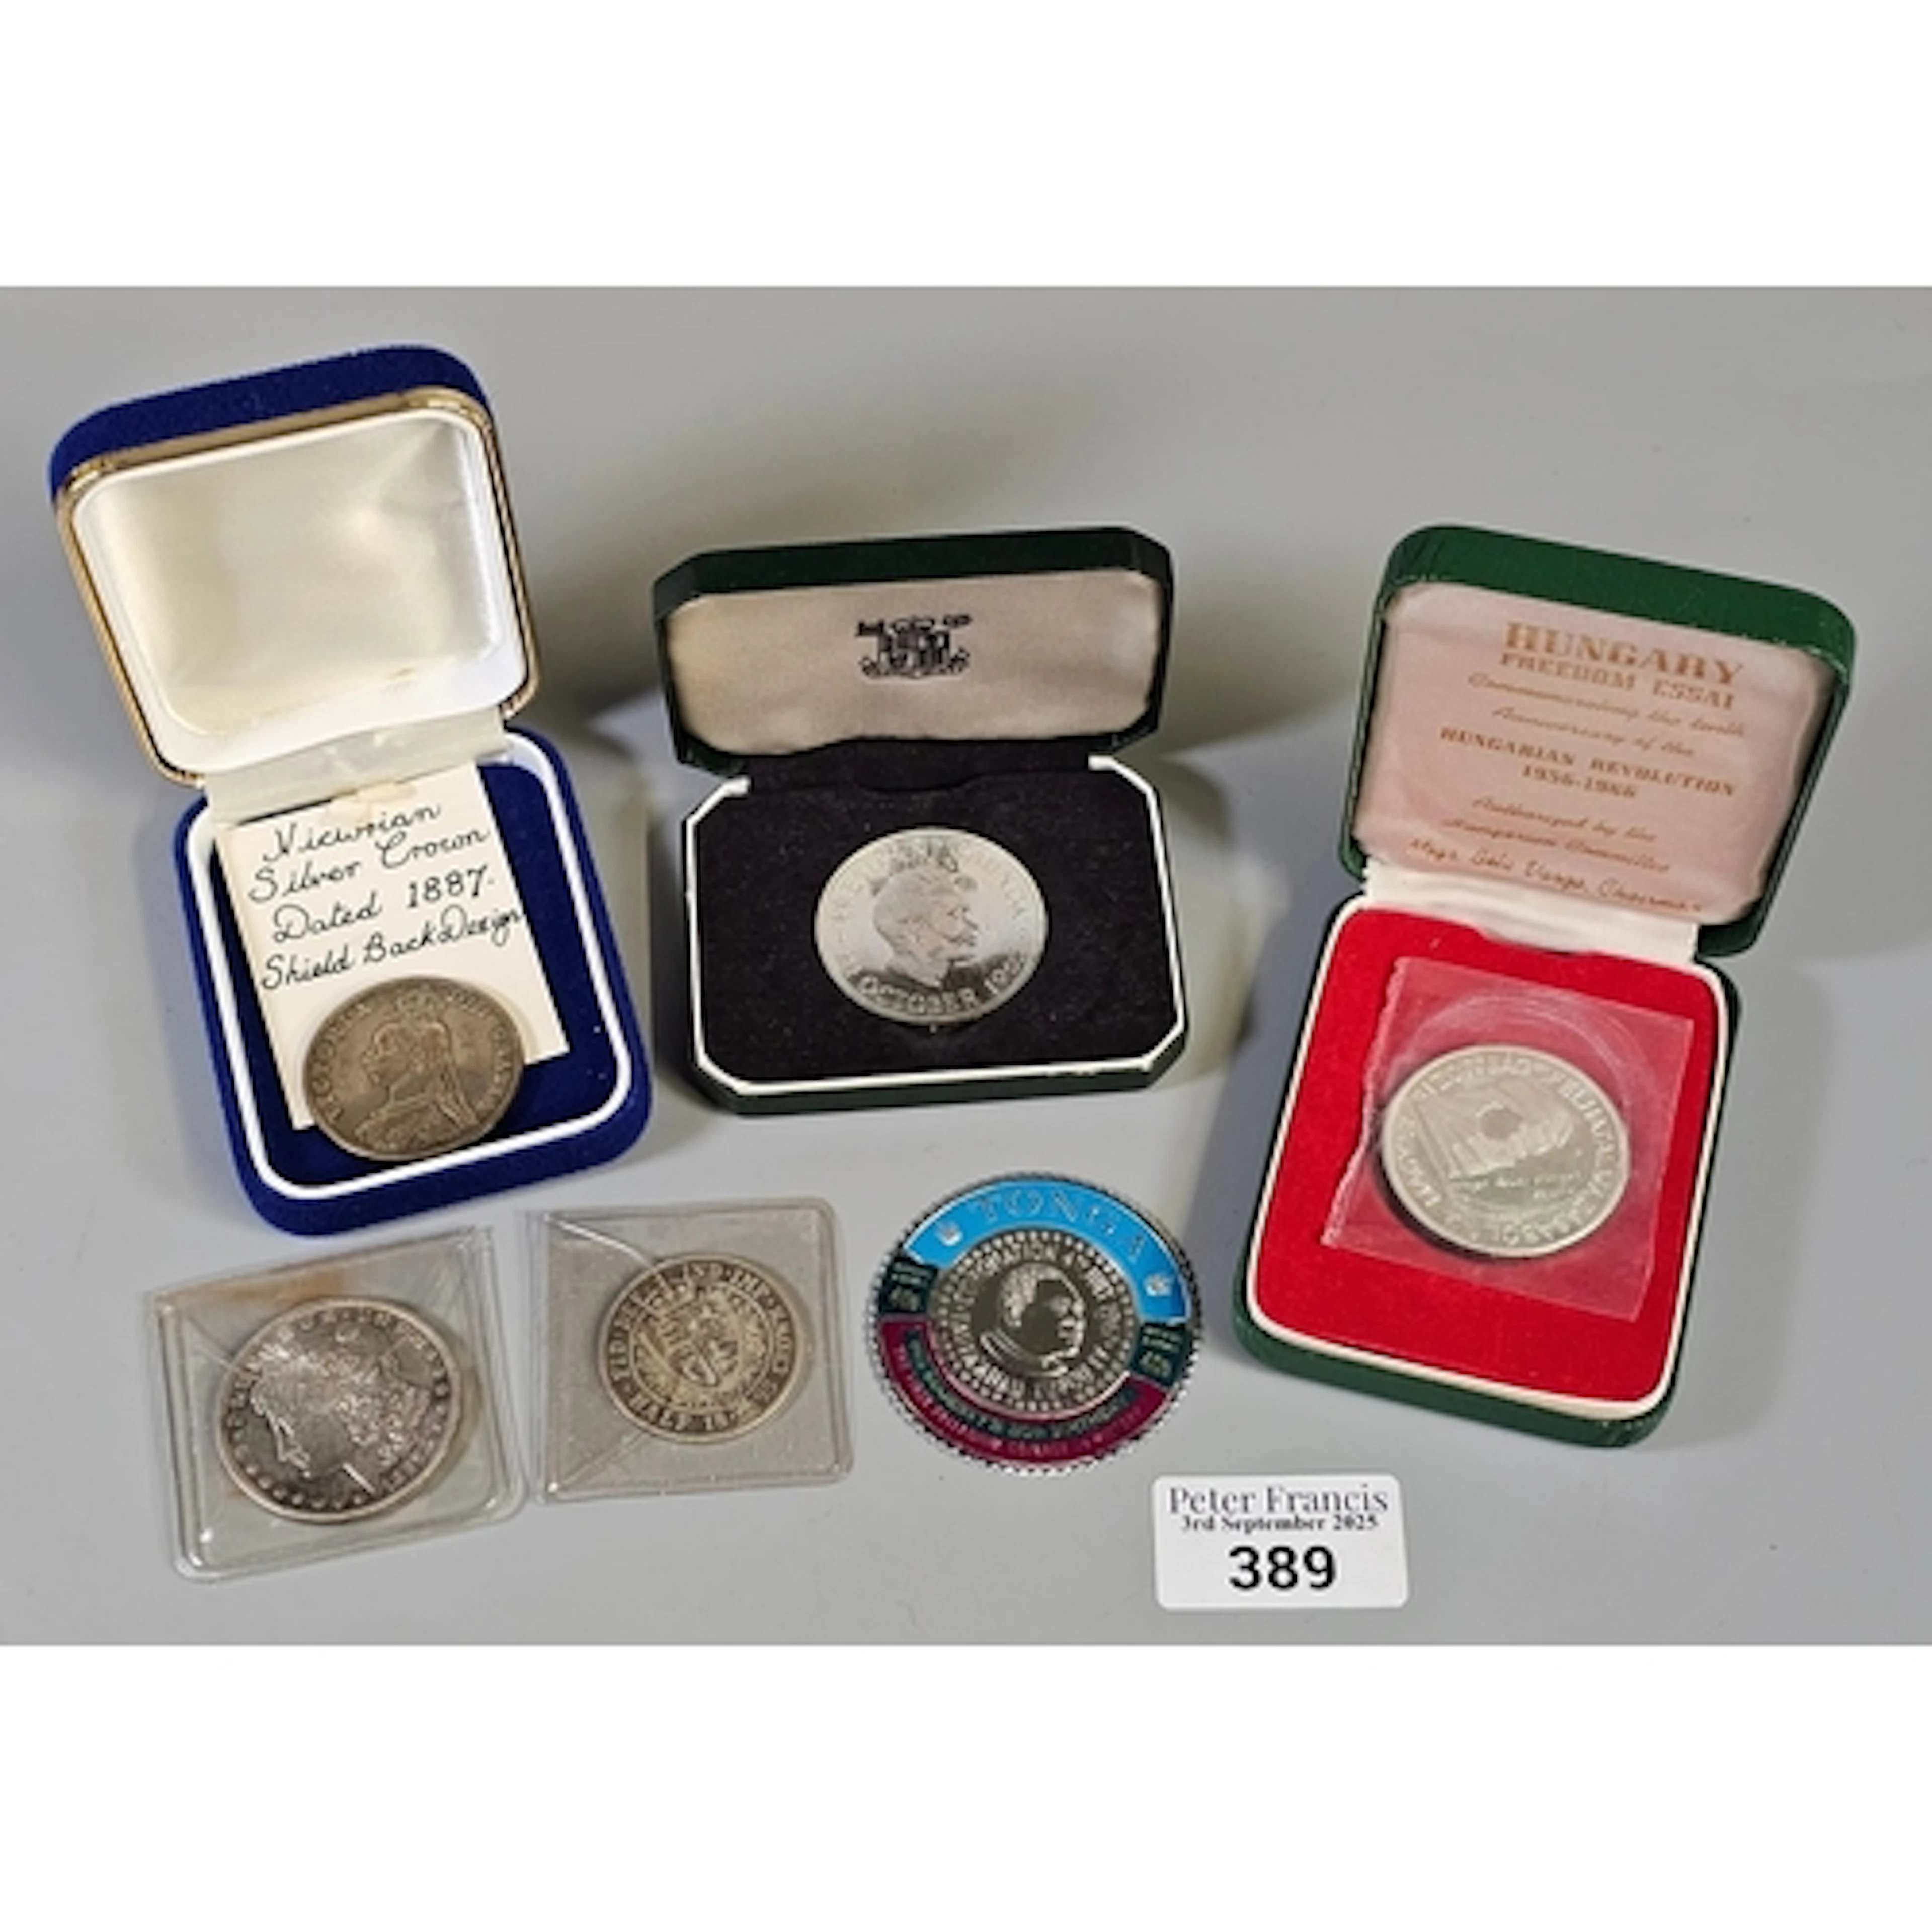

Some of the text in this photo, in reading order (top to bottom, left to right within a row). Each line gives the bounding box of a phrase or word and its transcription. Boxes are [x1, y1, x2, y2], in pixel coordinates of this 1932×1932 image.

[1505, 621, 1743, 685] HUNGARY
[1498, 652, 1735, 709] FREEDOM ESSAI
[1439, 726, 1735, 796] HUNGARIAN REVOLUTION
[1632, 733, 1654, 752] of
[1521, 764, 1636, 799] 1956-1966
[248, 827, 489, 903] Silver Crown
[272, 892, 383, 942] Dated
[261, 943, 356, 990] Shield
[1170, 1483, 1388, 1514] Peter Francis
[1182, 1514, 1379, 1535] 3rd September 2025
[1229, 1546, 1336, 1591] 389
